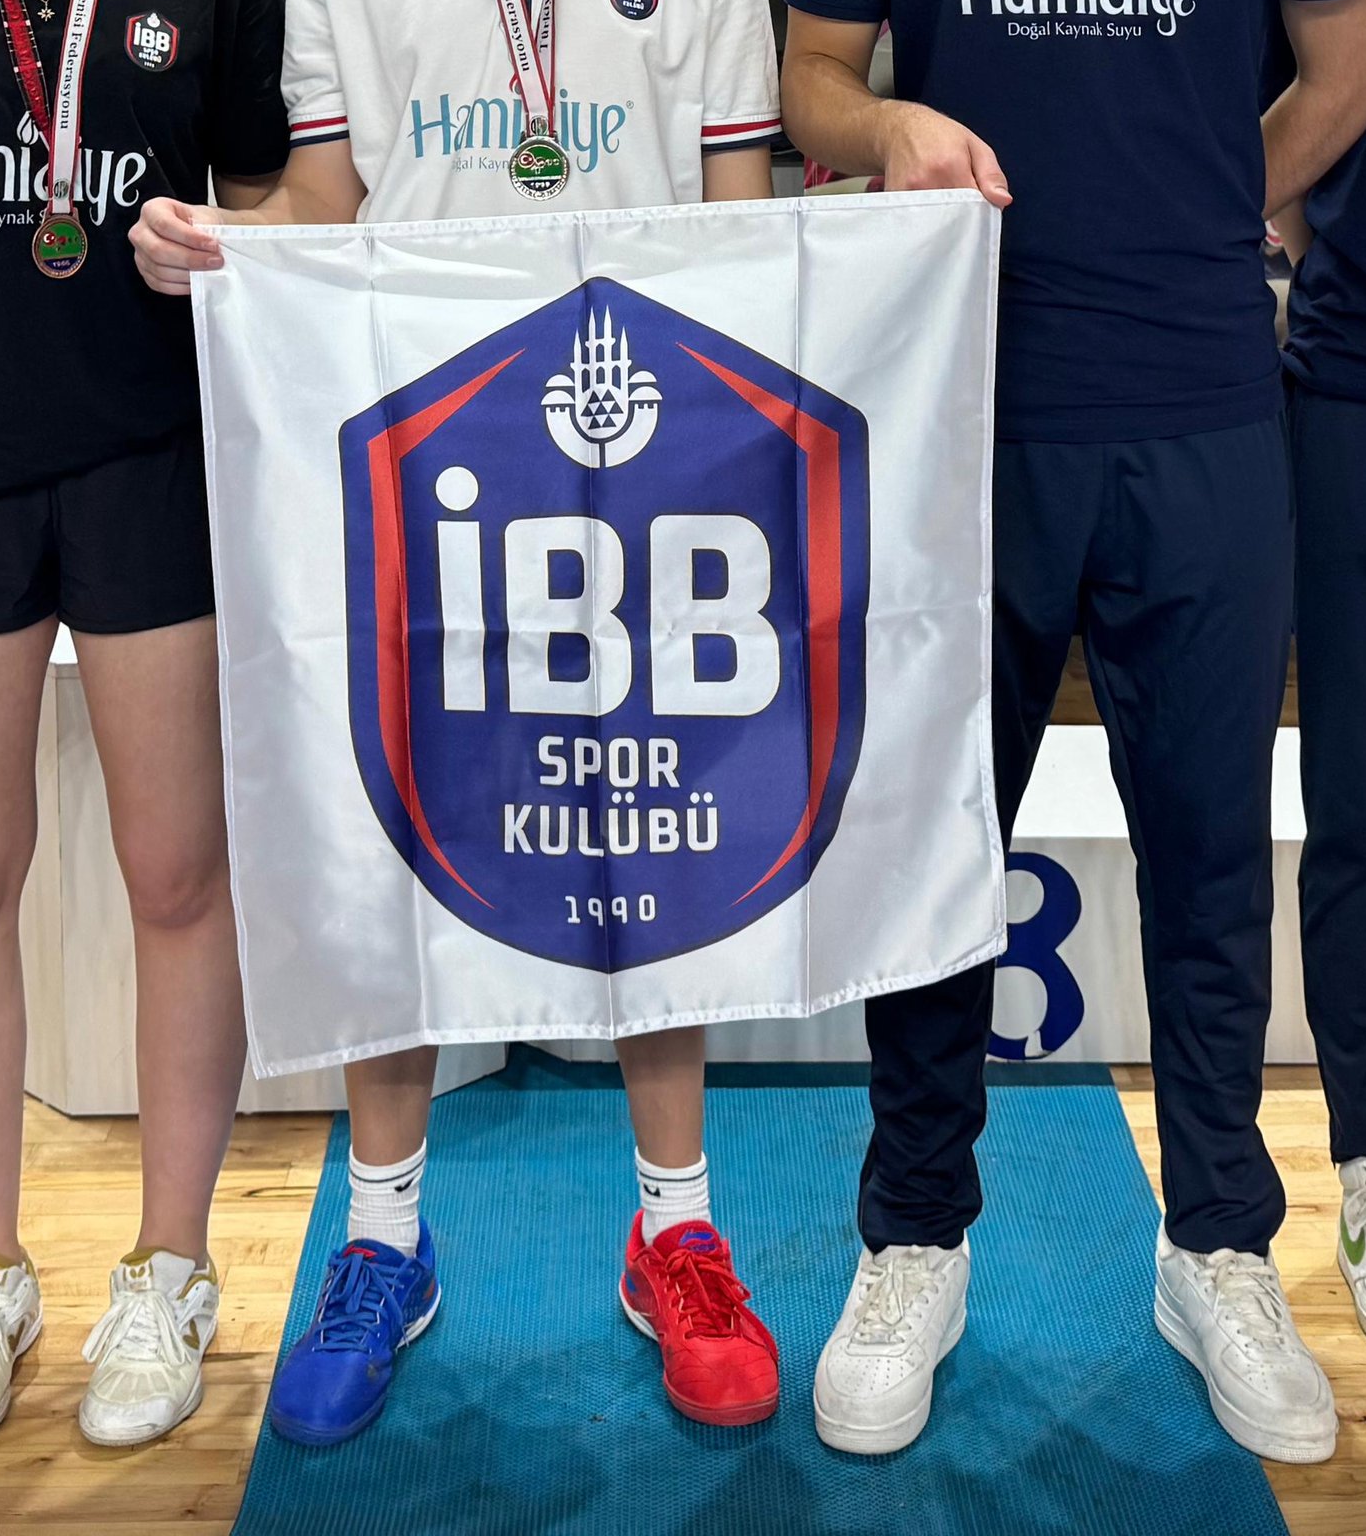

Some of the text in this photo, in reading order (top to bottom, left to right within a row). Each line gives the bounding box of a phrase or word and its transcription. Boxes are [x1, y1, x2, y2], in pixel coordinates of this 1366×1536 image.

[1007, 21, 1142, 40] Doğal Kaynak Suyu
[407, 89, 627, 173] Hamiiye
[435, 465, 781, 717] İBB
[538, 735, 681, 789] SPOR
[503, 791, 719, 858] KULÜBÜ
[566, 893, 657, 927] 1990
